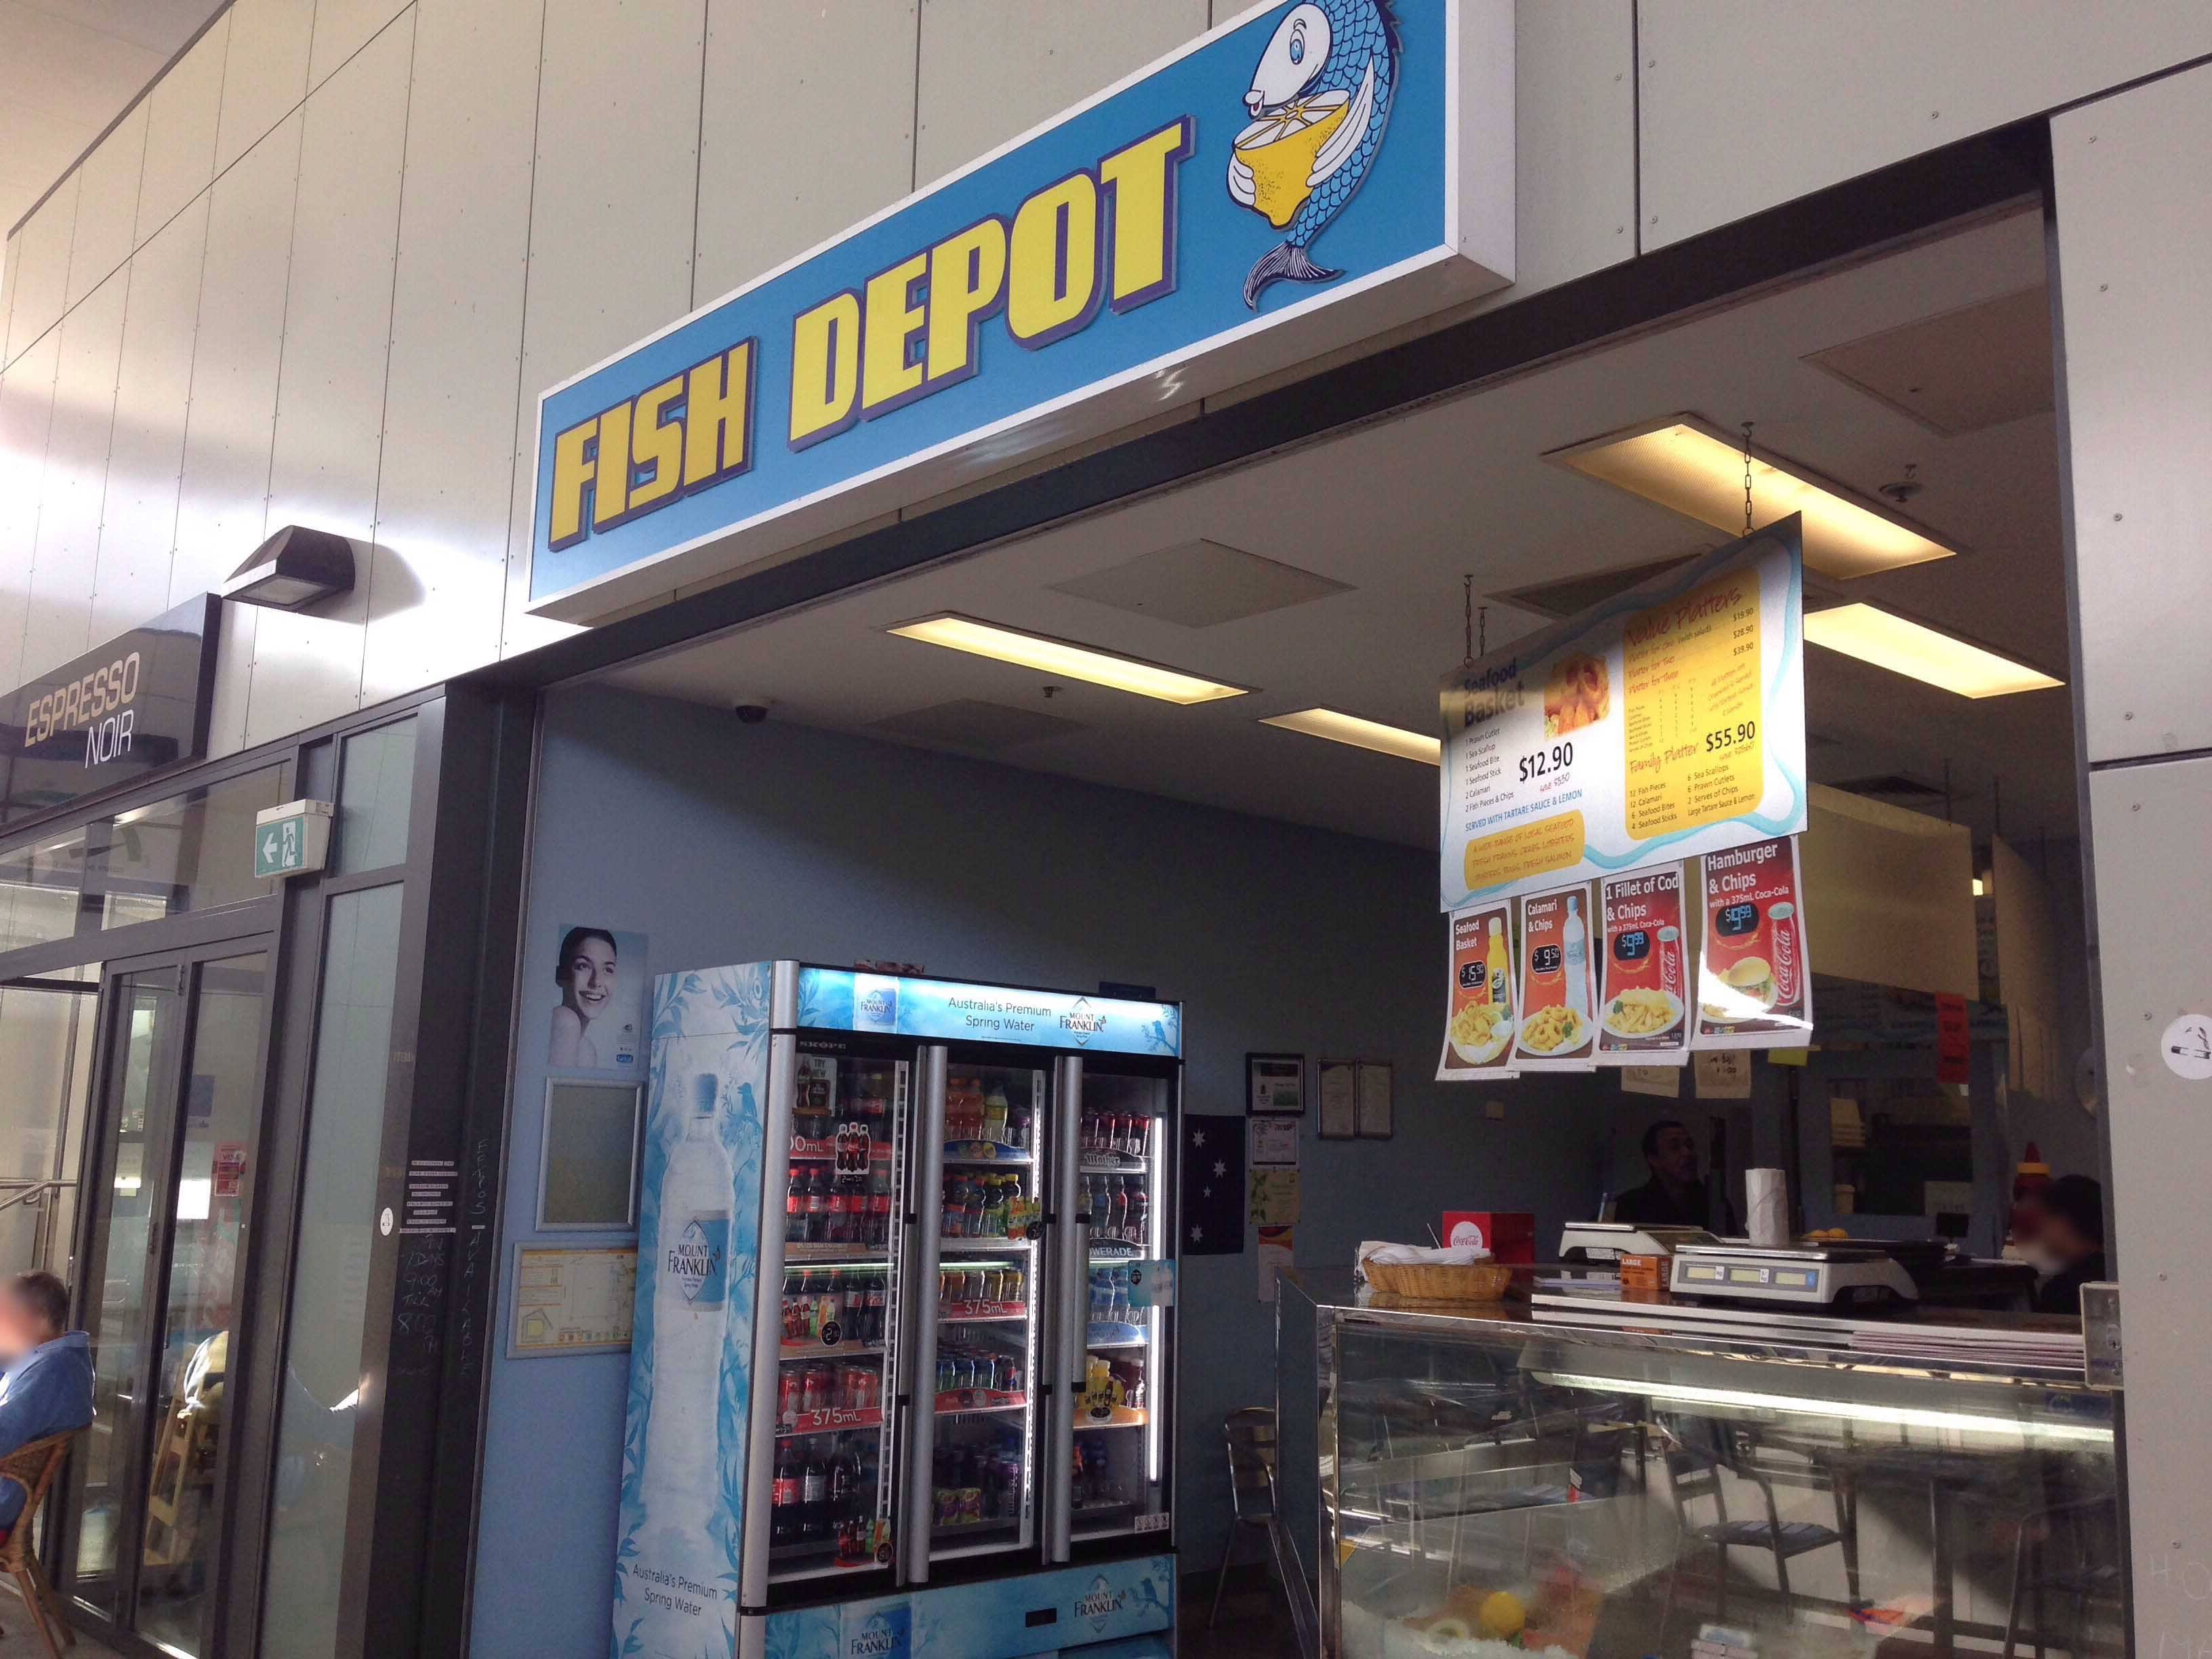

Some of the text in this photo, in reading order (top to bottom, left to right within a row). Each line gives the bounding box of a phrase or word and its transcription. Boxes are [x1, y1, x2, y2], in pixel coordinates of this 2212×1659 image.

[548, 113, 1196, 553] FISH DEPOT
[1675, 587, 1742, 630] Platters
[1732, 607, 1754, 621] $19.90
[1732, 625, 1754, 638] $28.90
[1732, 642, 1754, 656] $39.90
[1464, 657, 1517, 693] Seafood
[25, 651, 140, 748] ESPRESSO
[1464, 680, 1525, 728] Basket
[85, 710, 134, 769] NOIR
[1469, 733, 1485, 745] Prawn
[1485, 727, 1500, 739] Cutlet
[1706, 721, 1756, 752] $55.90
[1469, 748, 1478, 758] Sea
[1478, 743, 1496, 756] Scallop
[1630, 752, 1661, 774] Family
[1664, 741, 1699, 764] Platter
[1469, 759, 1489, 772] Seafood
[1519, 741, 1574, 784] $12.90
[1469, 771, 1490, 785] Seafood
[1490, 768, 1501, 778] Stick
[1694, 770, 1705, 780] Sea
[1705, 764, 1729, 777] Scallops
[1638, 786, 1649, 796] Fish
[1650, 782, 1666, 793] Pieces
[1694, 779, 1713, 791] Prawn
[1713, 774, 1735, 785] Cutlets
[1495, 795, 1500, 803] &
[1500, 791, 1515, 802] Chips
[1694, 792, 1713, 803] Serves
[1713, 790, 1721, 798] of
[1721, 785, 1739, 797] Chips
[1465, 789, 1582, 832] SERVED WITH TARTARE SAUCE & LEMON
[1639, 805, 1660, 818] Seafood
[1662, 802, 1675, 812] Bites
[1687, 807, 1701, 817] Large
[1738, 794, 1755, 804] Lemon
[1638, 816, 1661, 829] Seafood
[1661, 813, 1677, 823] Sticks
[1707, 843, 1778, 872] Hamburger
[1606, 873, 1679, 899] 1 Fillet of Cod
[1708, 872, 1757, 895] & Chips
[1709, 898, 1725, 909] with
[1731, 893, 1755, 905] 375mL
[1755, 886, 1789, 900] Coca-Cola
[1528, 899, 1557, 916] Calamari
[1607, 903, 1647, 921] & Chips
[1456, 919, 1479, 935] Seafood
[1528, 919, 1553, 933] & Chips
[1607, 924, 1618, 933] with
[1622, 922, 1639, 931] 375mL
[1639, 919, 1664, 928] Coca-Cola
[1456, 937, 1477, 950] Basket
[861, 1002, 890, 1014] FRANKLIN
[949, 997, 1052, 1017] Australia's Premium
[966, 1015, 1035, 1031] Spring Water
[1060, 1015, 1103, 1032] FRANKLIN
[1069, 1012, 1094, 1021] MOUNT
[678, 1244, 708, 1256] MOUNT
[1089, 1247, 1134, 1256] WERADE
[668, 1250, 717, 1276] FRANKLIN
[1622, 1258, 1642, 1266] LARGE
[964, 1298, 1008, 1315] 375mL
[811, 1407, 861, 1426] 375mL
[632, 1563, 718, 1600] Australia's Premium
[644, 1587, 702, 1616] Spring Water
[1085, 1591, 1113, 1602] MOUNT
[1074, 1598, 1123, 1618] FRANKLIN
[861, 1629, 893, 1641] MOUNT
[851, 1635, 901, 1656] FRANKLIN
